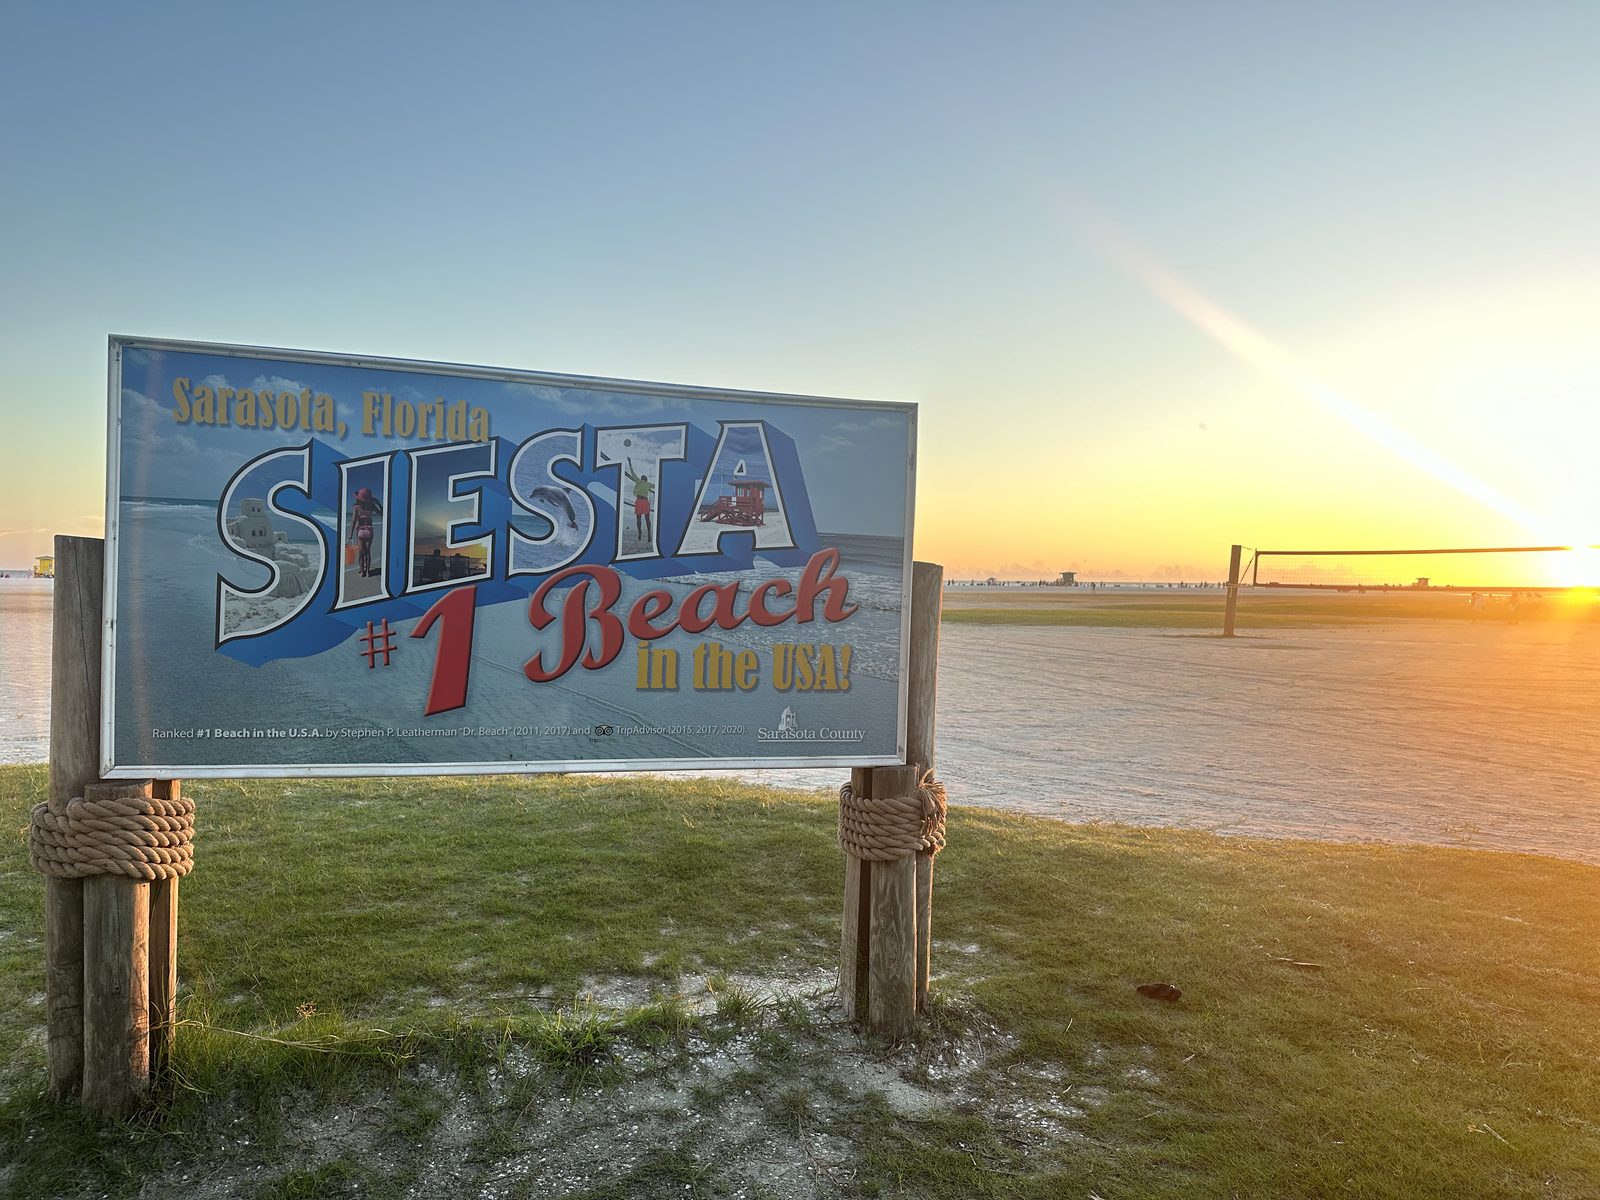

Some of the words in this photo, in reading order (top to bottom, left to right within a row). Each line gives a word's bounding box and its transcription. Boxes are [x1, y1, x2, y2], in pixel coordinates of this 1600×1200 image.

[171, 376, 346, 438] Sarasota,
[361, 391, 490, 442] Florida
[214, 419, 800, 651] SIESTA
[523, 546, 859, 684] Beach
[636, 641, 679, 690] in
[692, 642, 759, 690] the
[772, 643, 853, 690] USA!
[152, 728, 194, 738] Ranked
[196, 728, 211, 738] #1
[214, 728, 250, 738] Beach
[252, 728, 264, 738] in
[266, 728, 286, 738] the
[288, 728, 323, 738] U.S.A.
[325, 727, 339, 739] by
[341, 727, 384, 739] Stephen
[386, 727, 395, 737] P.
[397, 727, 457, 737] Leatherman
[513, 727, 543, 736] (2011,
[544, 726, 571, 736] 2017)
[572, 725, 591, 735] and
[616, 725, 666, 735] TripAdvisor
[668, 725, 695, 735] (2015,
[696, 725, 720, 735] 2017,
[757, 728, 816, 740] Sarasota
[819, 728, 866, 742] County
